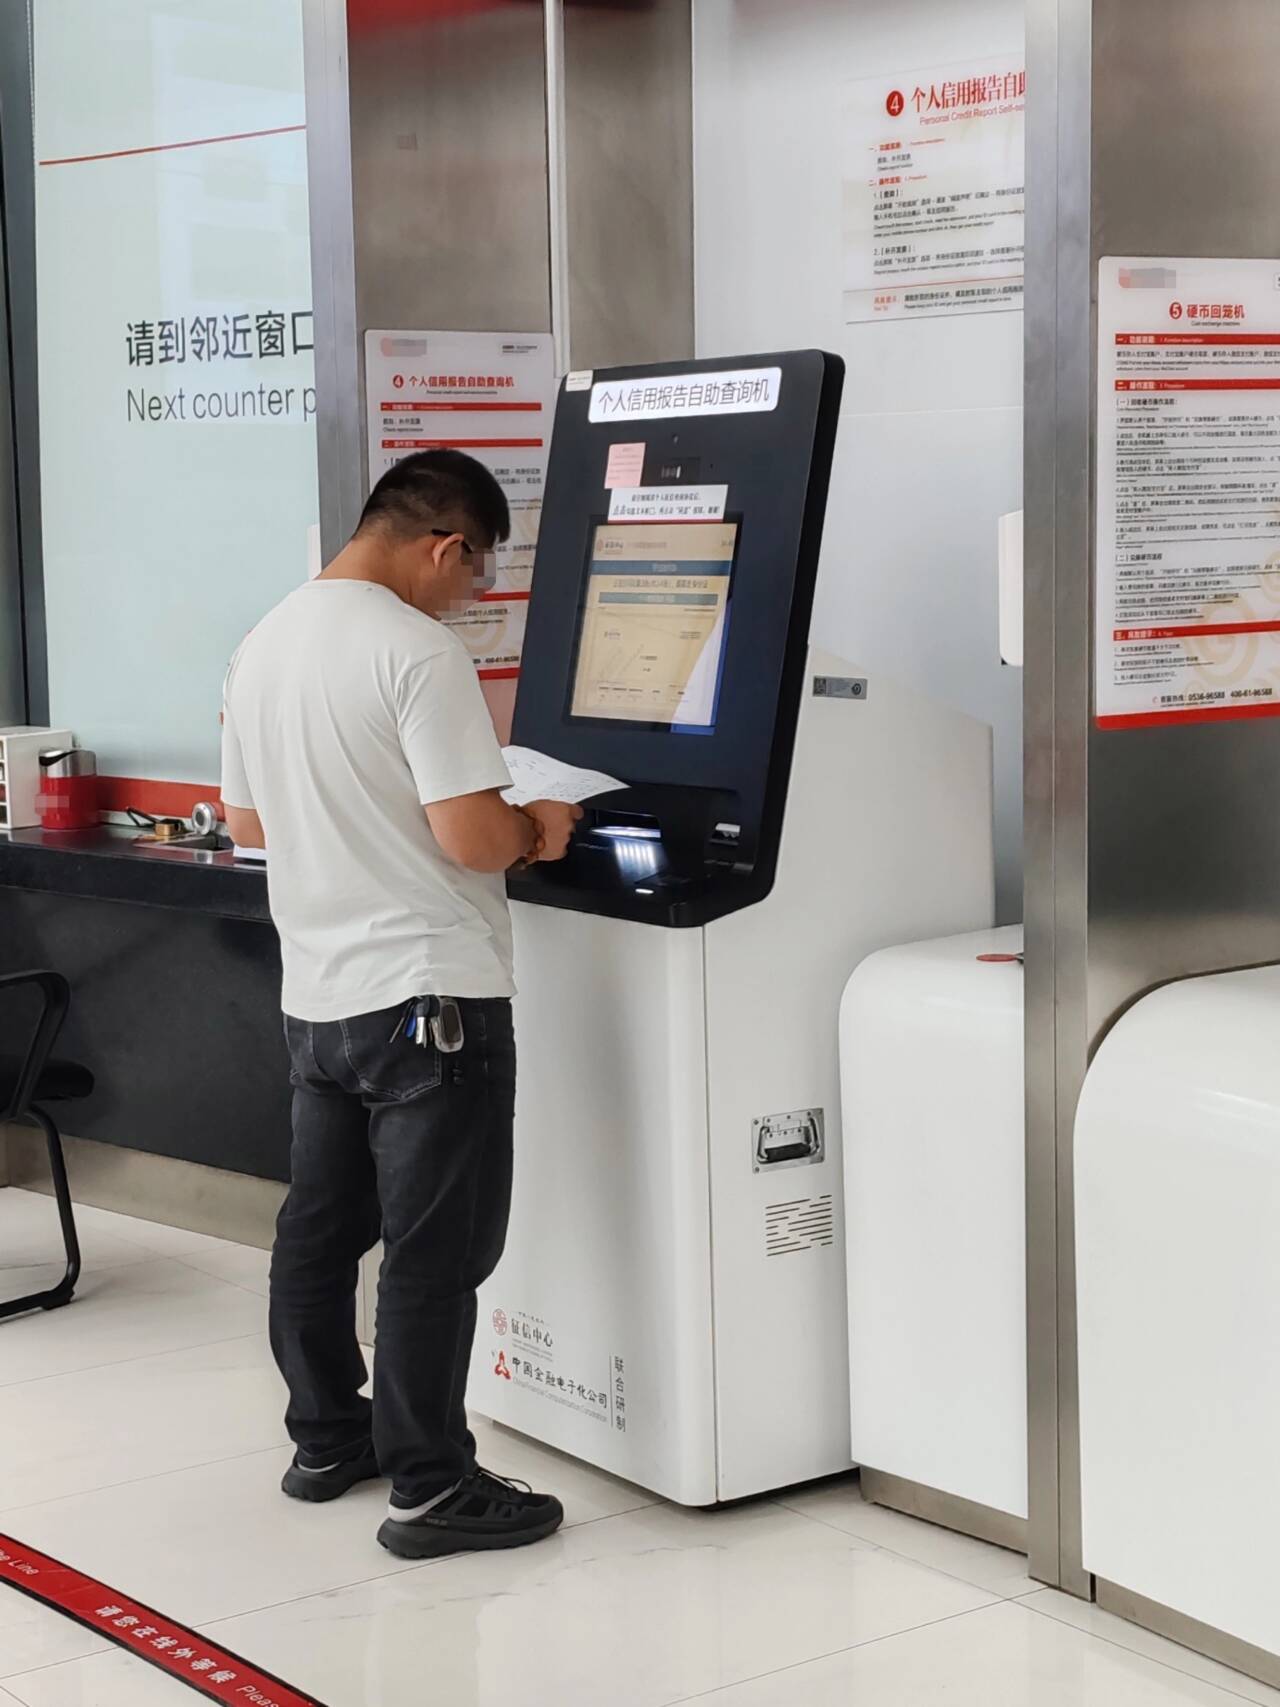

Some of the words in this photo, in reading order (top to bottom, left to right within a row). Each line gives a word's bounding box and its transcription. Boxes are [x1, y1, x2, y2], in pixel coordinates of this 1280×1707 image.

[951, 109, 973, 121] Credit
[1170, 303, 1182, 319] 5
[1186, 304, 1245, 319] 硬币回笼机
[126, 310, 314, 367] 请到邻近窗口
[127, 387, 186, 421] Next
[193, 383, 295, 419] counter
[599, 378, 770, 414] 个人信用报告自助查询机
[511, 1317, 553, 1347] 征信中心
[512, 1356, 607, 1408] 中国金融电子化公司
[8, 1559, 39, 1576] Line
[95, 1604, 237, 1684] 请您在线外等候
